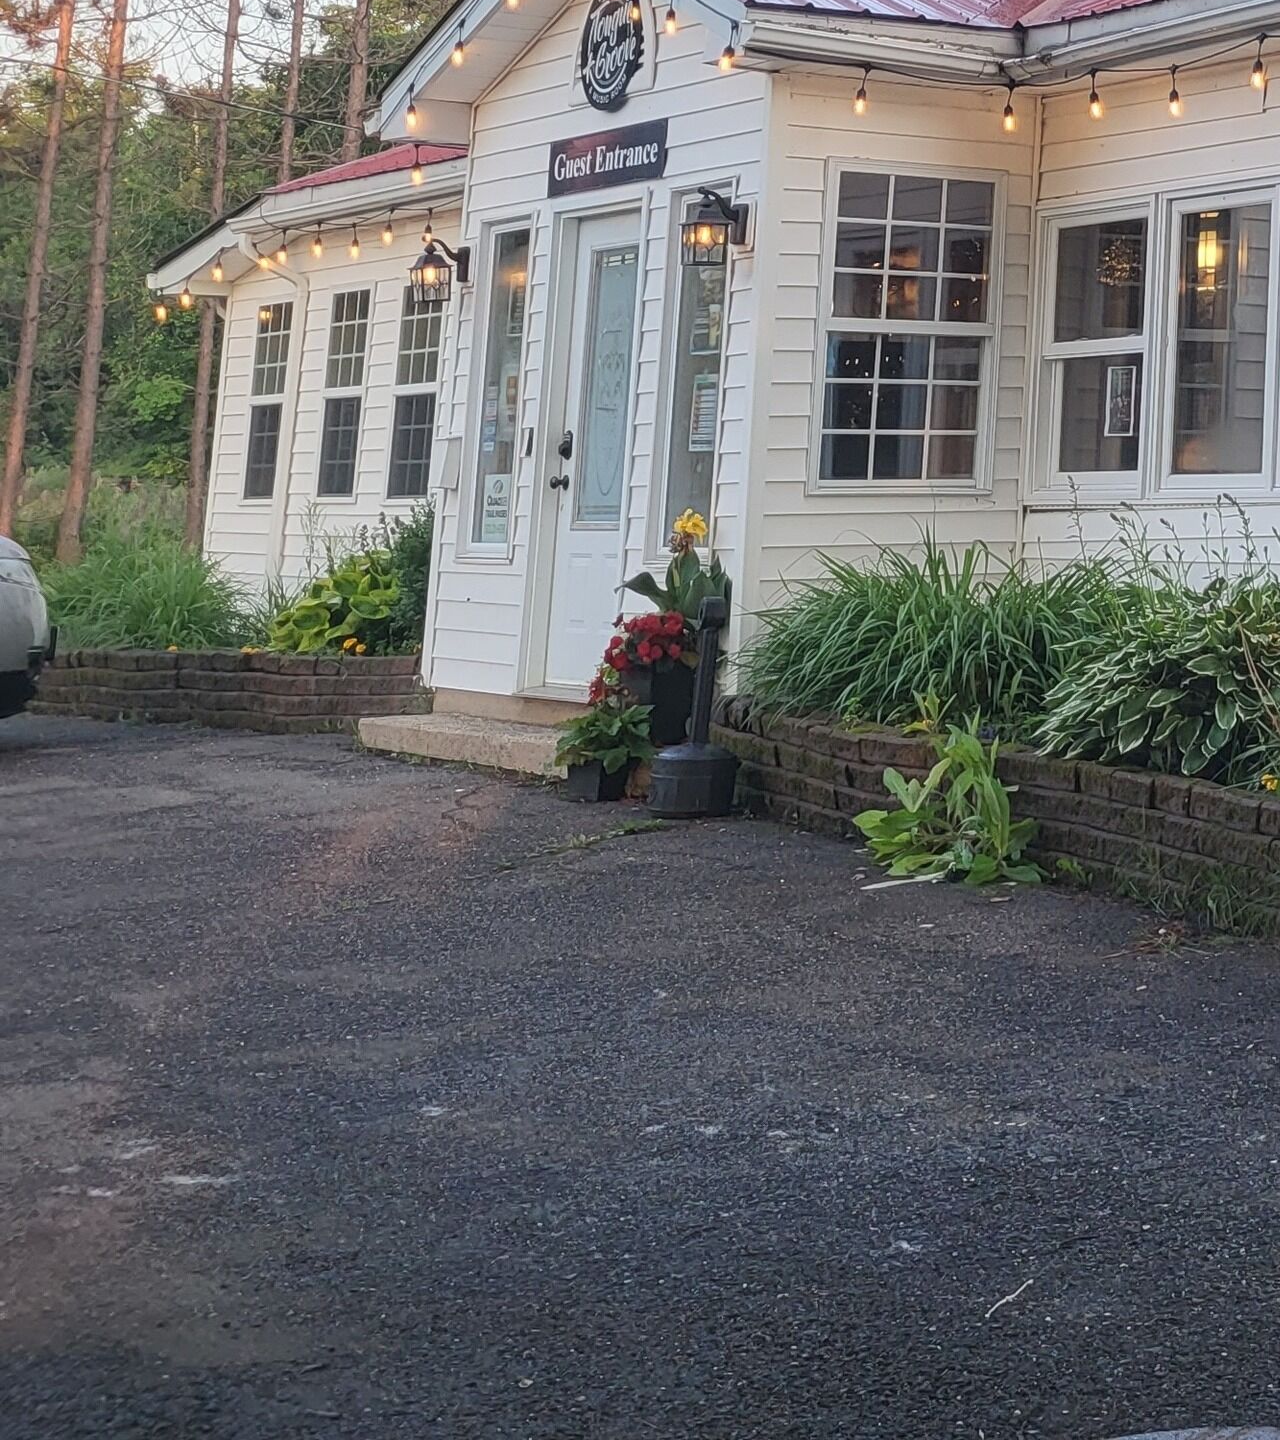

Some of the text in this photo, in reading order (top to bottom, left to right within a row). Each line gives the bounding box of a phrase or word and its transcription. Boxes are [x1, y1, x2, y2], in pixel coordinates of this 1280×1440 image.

[595, 35, 637, 80] Groove
[554, 142, 658, 181] Guest Entrance
